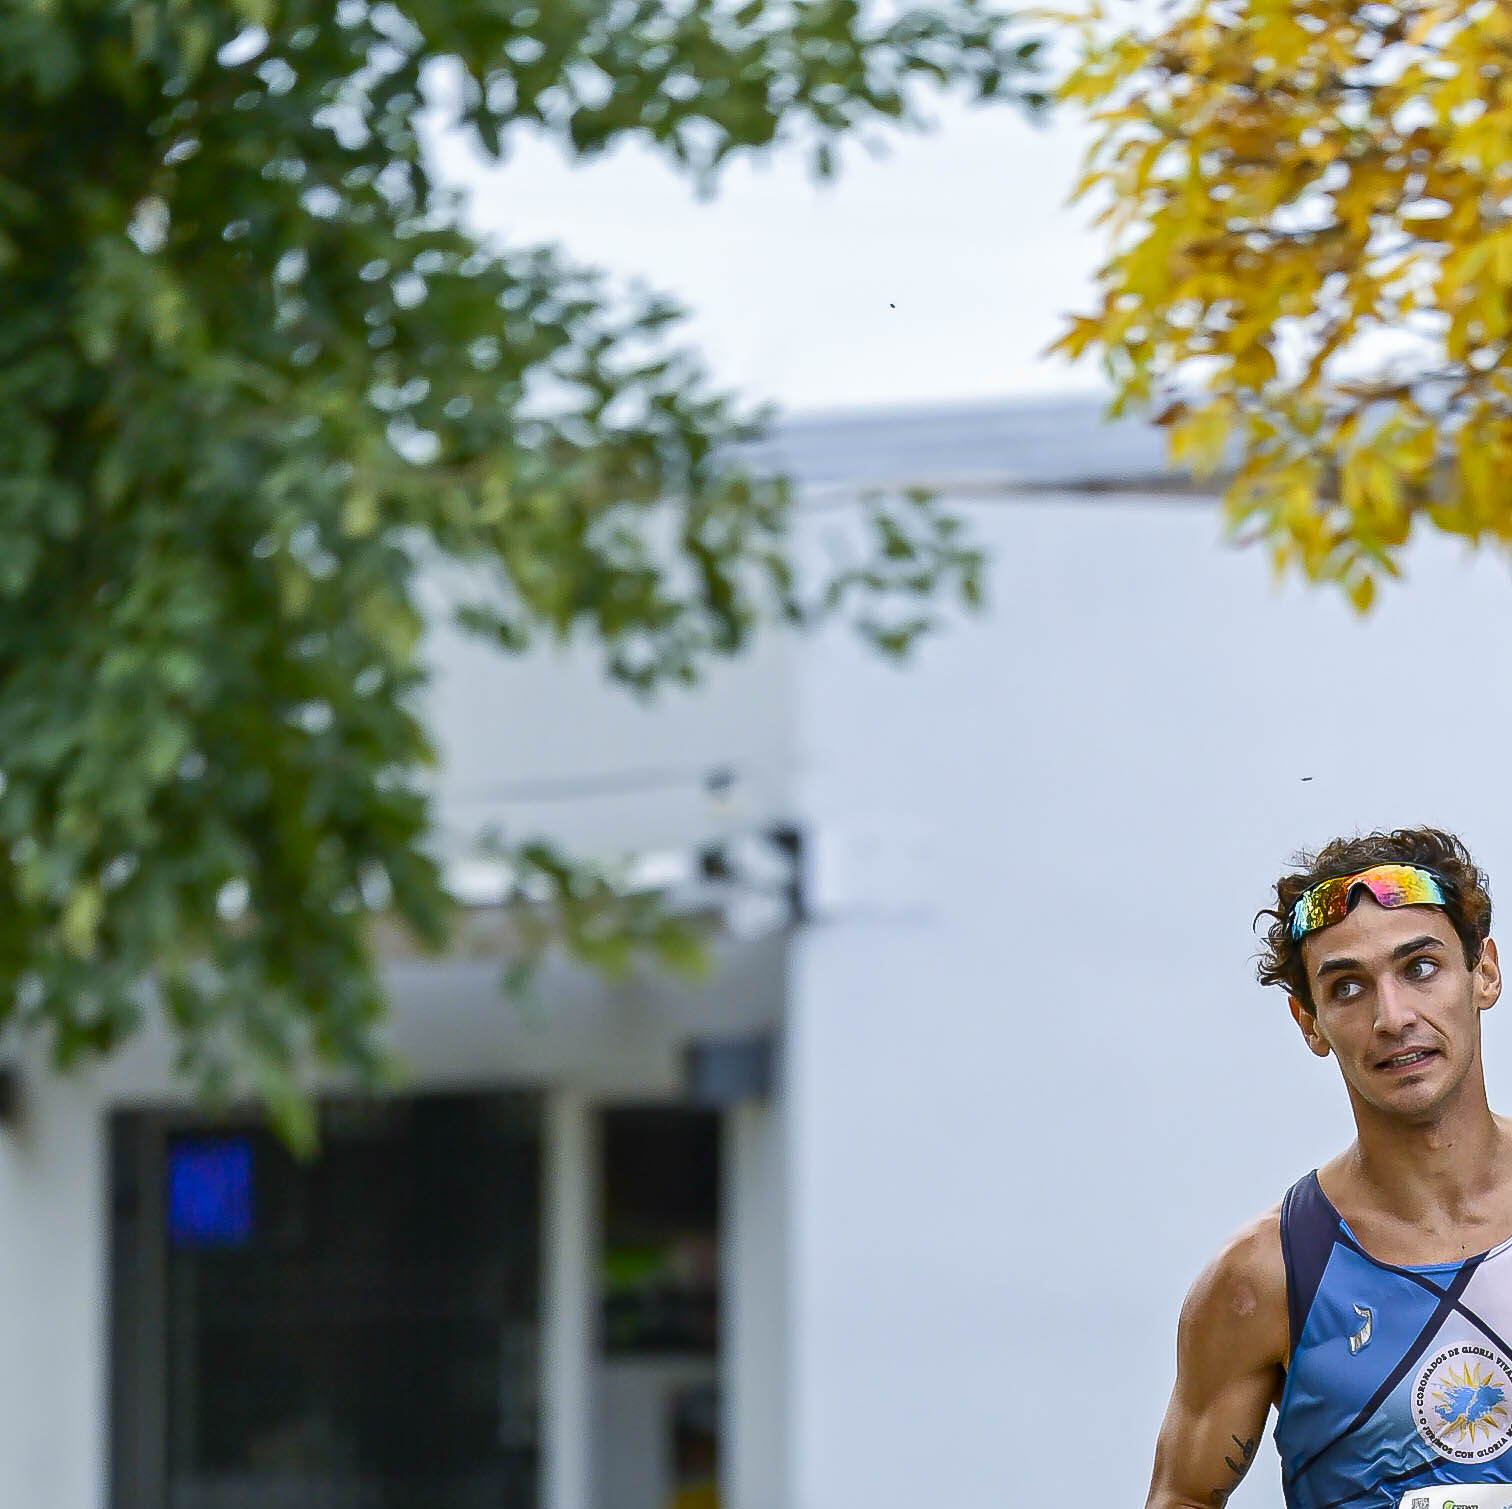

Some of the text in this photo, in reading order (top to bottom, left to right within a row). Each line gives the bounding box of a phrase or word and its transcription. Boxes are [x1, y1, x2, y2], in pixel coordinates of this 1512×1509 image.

[1417, 1353, 1448, 1406] CORONADOS
[1448, 1347, 1460, 1358] DE
[1461, 1346, 1495, 1360] GLORIA
[1454, 1450, 1474, 1459] CON
[1477, 1437, 1509, 1458] GLORIA
